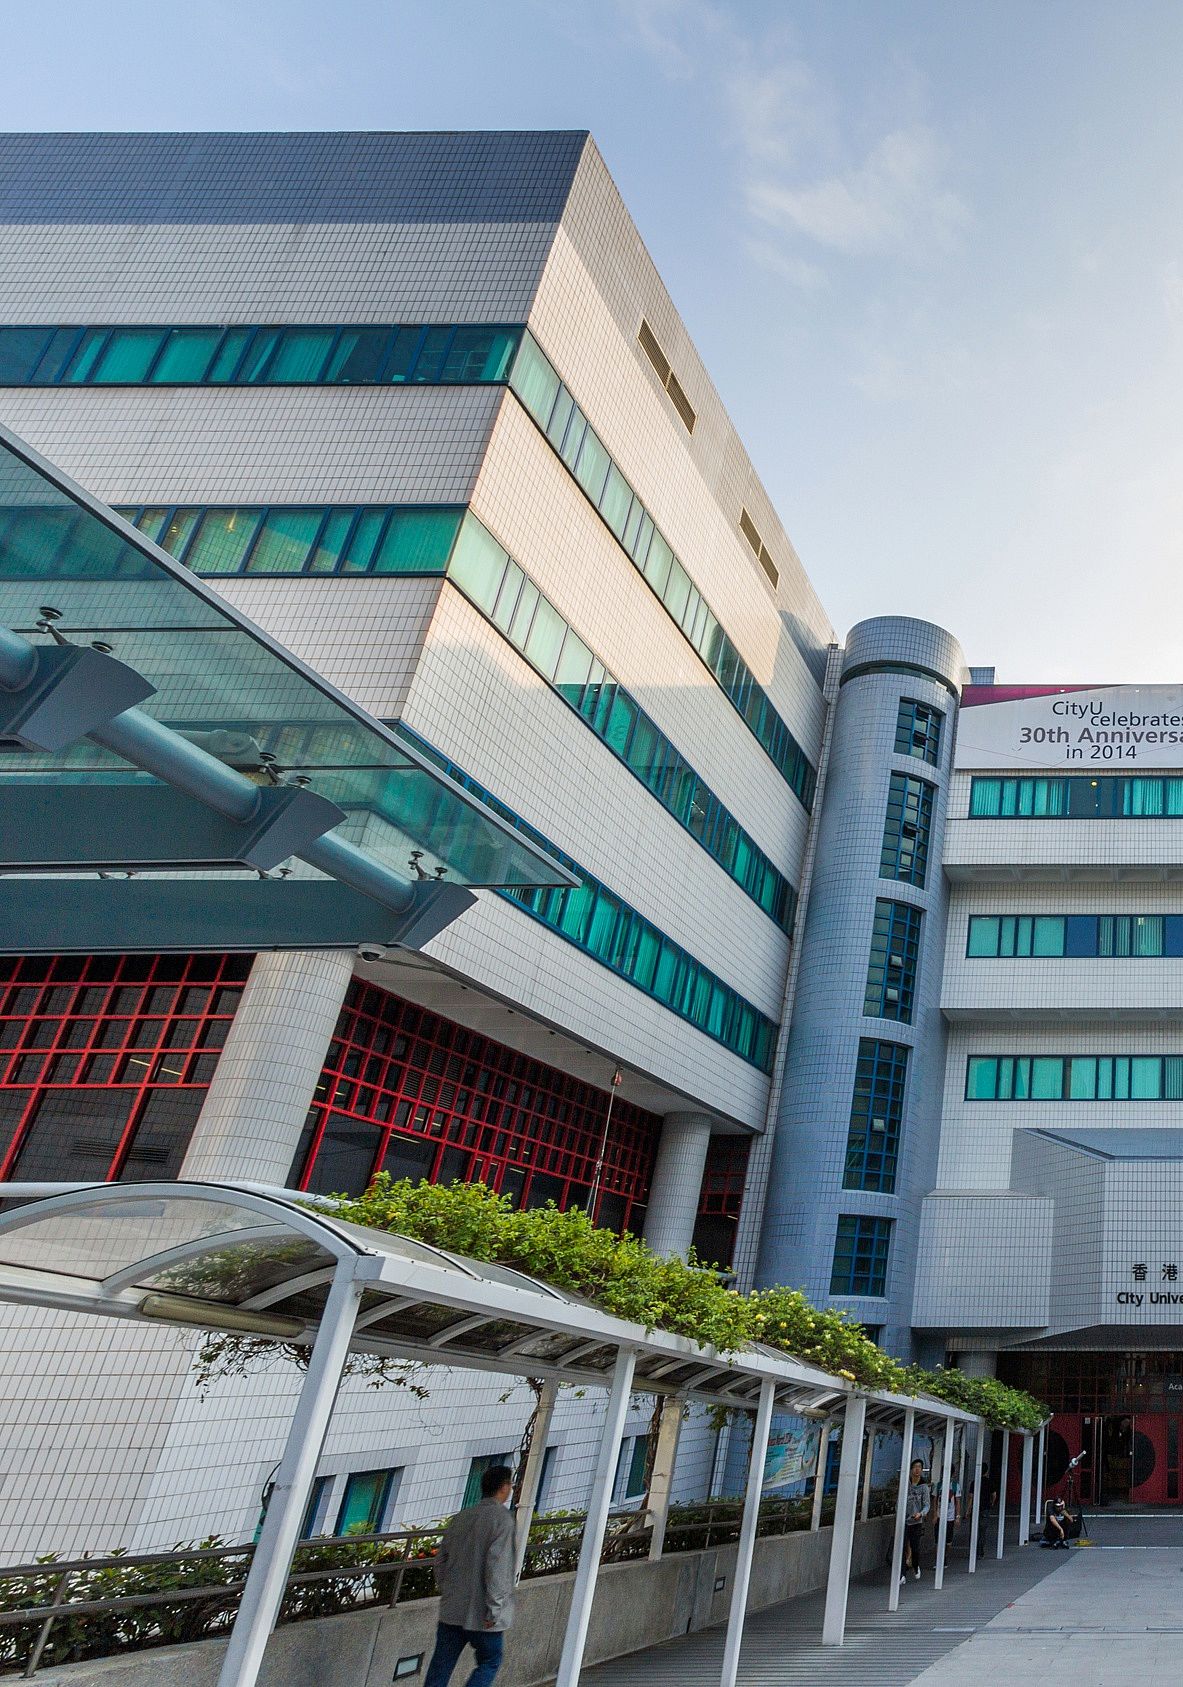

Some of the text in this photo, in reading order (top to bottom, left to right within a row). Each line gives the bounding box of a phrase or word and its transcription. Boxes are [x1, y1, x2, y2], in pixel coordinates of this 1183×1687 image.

[1052, 701, 1103, 719] CityU
[1019, 727, 1070, 743] 30th
[1066, 745, 1137, 759] in 2014
[1117, 1291, 1144, 1307] City
